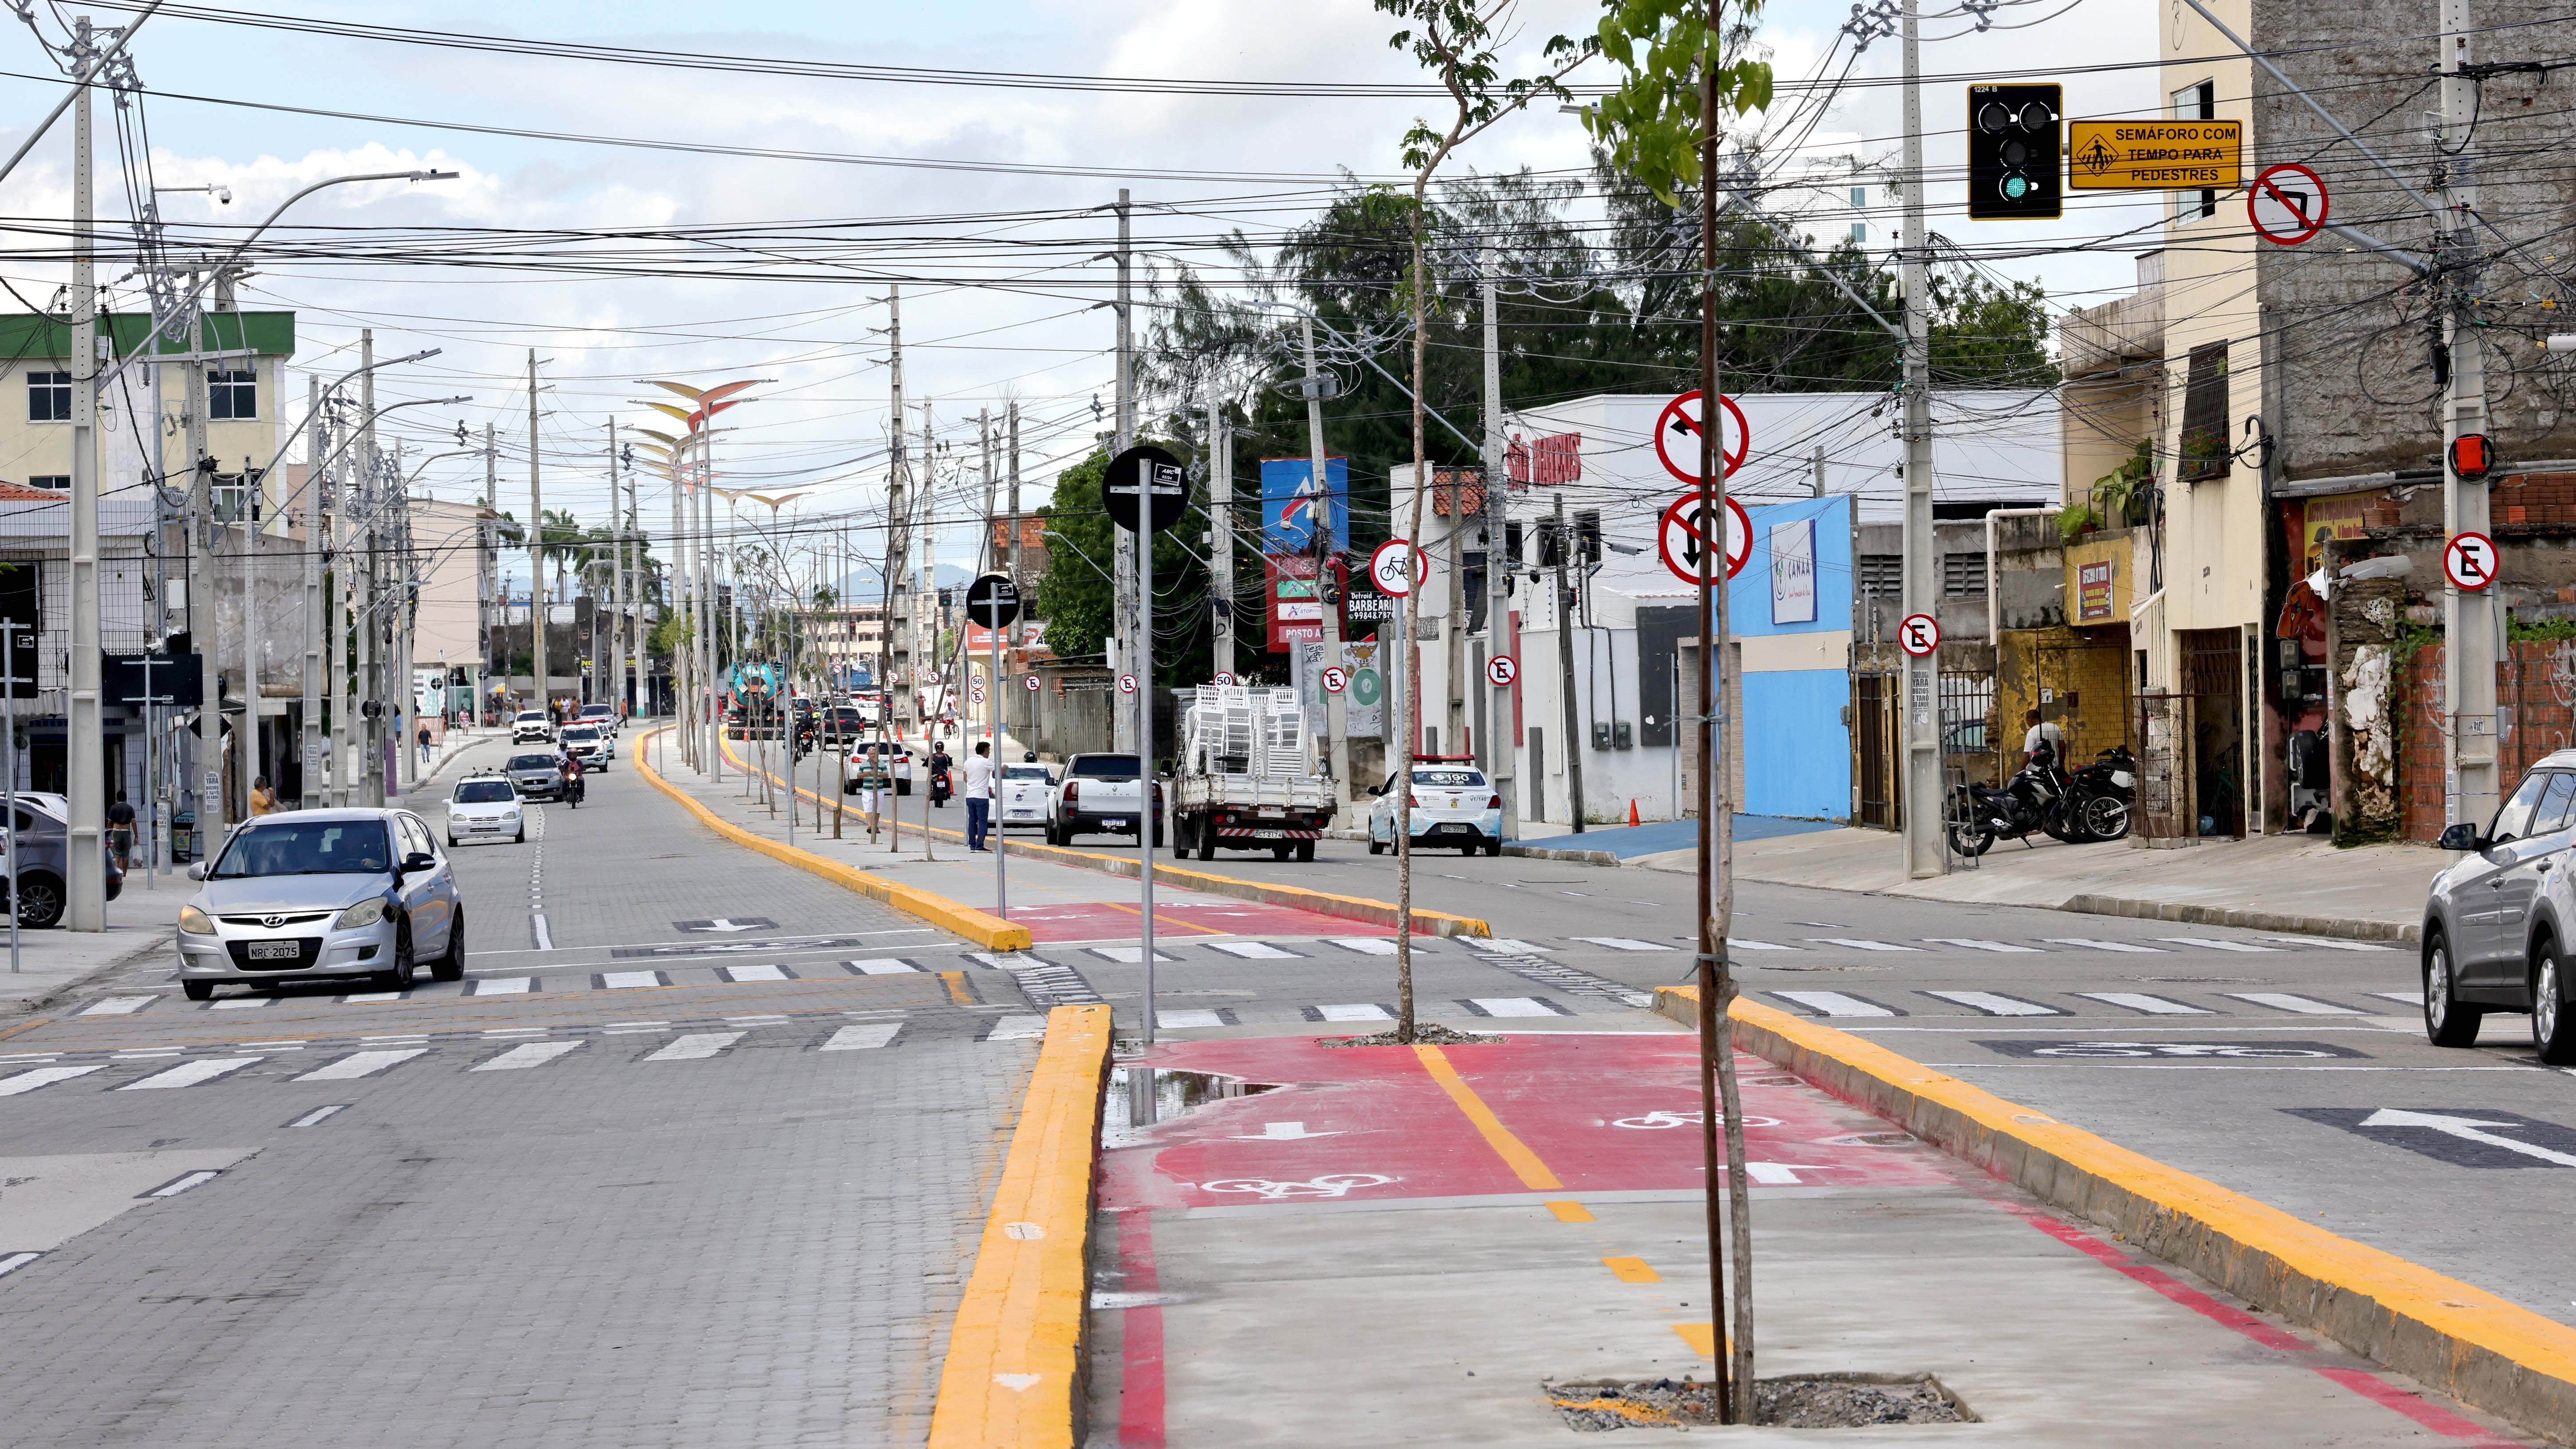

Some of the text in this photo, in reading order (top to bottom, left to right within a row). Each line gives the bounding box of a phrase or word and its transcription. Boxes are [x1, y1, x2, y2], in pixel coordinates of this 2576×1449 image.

[2115, 127, 2236, 141] SEMÁFORO COM
[2128, 149, 2223, 161] TEMPO PARA
[2131, 169, 2219, 181] PEDESTRES
[2461, 546, 2480, 577] E
[1349, 599, 1393, 612] BARBEARI
[1286, 628, 1313, 638] POSTO
[1912, 624, 1925, 647] E
[1497, 662, 1507, 678] E
[1030, 679, 1036, 687] E
[1125, 679, 1131, 688] E
[1217, 676, 1230, 685] 50
[1329, 673, 1339, 687] E
[251, 947, 297, 958] NRC-2075
